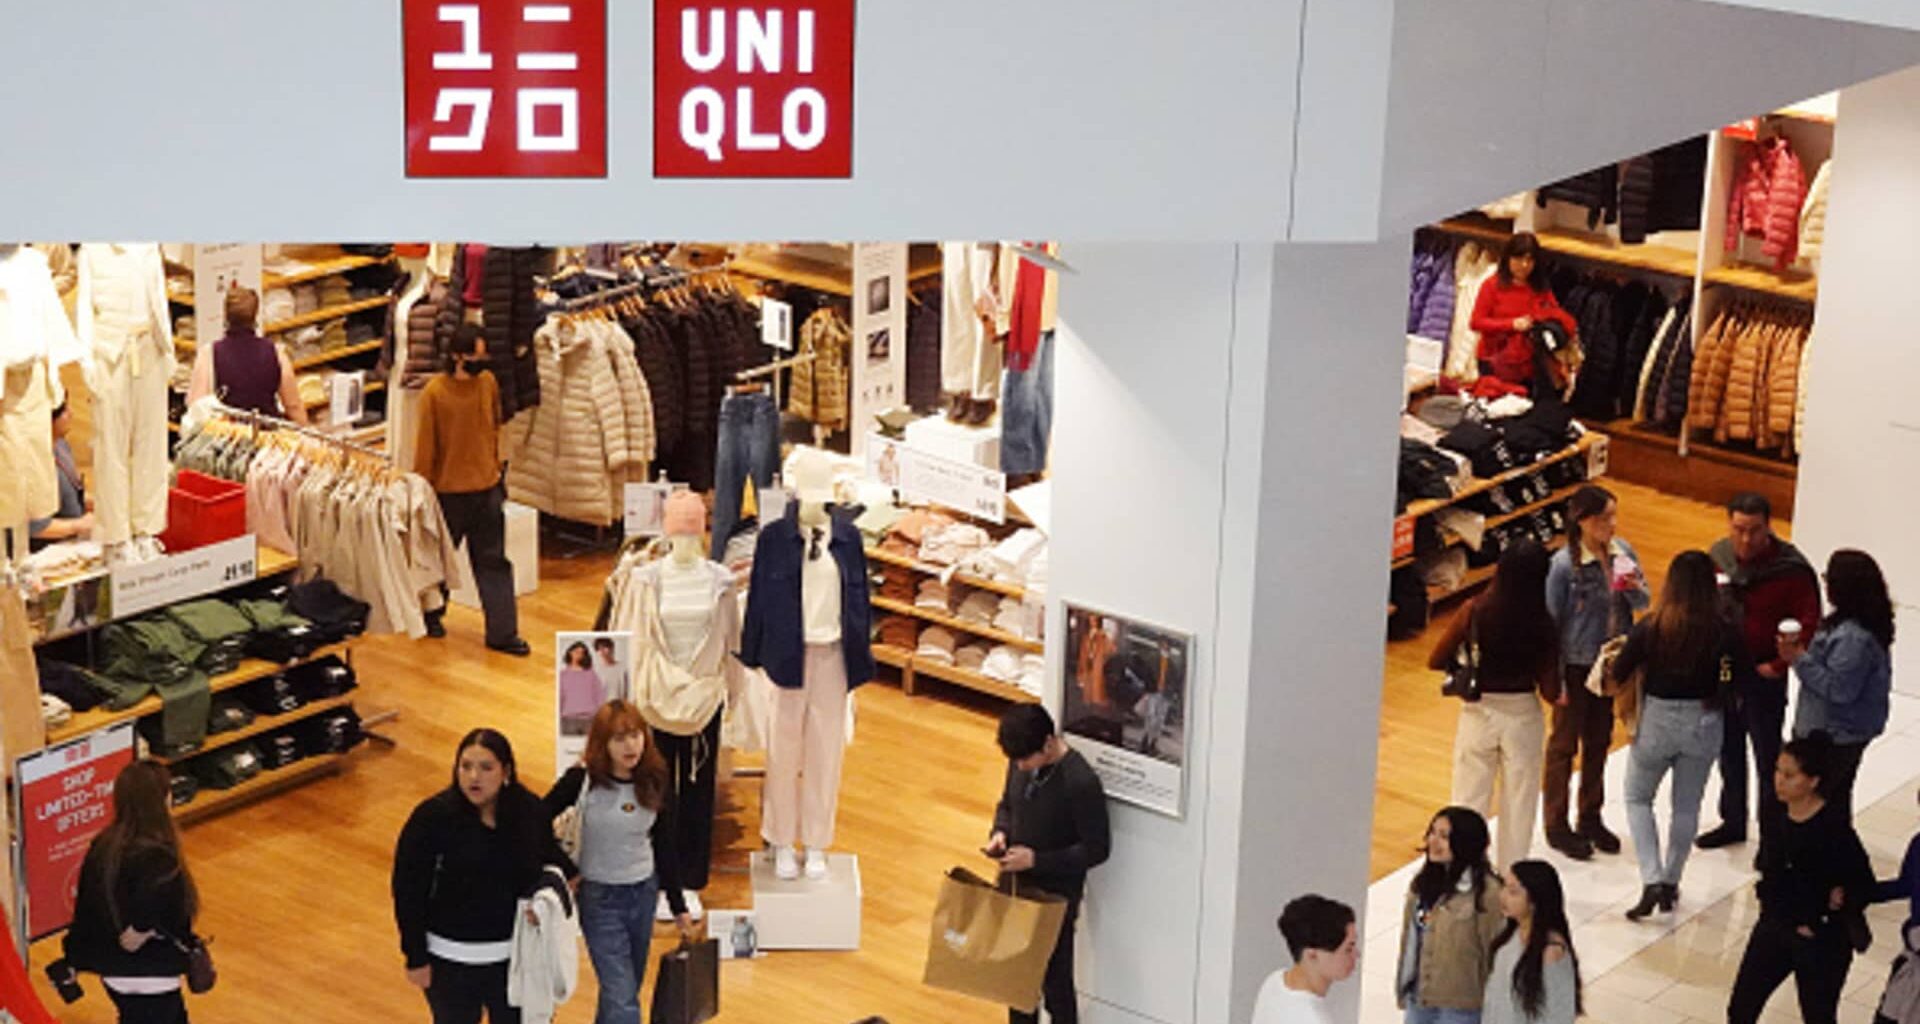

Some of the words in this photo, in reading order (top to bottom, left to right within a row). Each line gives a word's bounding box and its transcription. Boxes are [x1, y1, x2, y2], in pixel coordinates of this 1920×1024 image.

[432, 4, 578, 71] ユニ
[681, 8, 815, 74] UNI
[429, 88, 579, 151] クロ
[679, 86, 828, 161] QLO
[35, 779, 115, 821] LIMITED-TIM
[62, 767, 96, 792] SHOP
[56, 801, 105, 833] OFFERS
